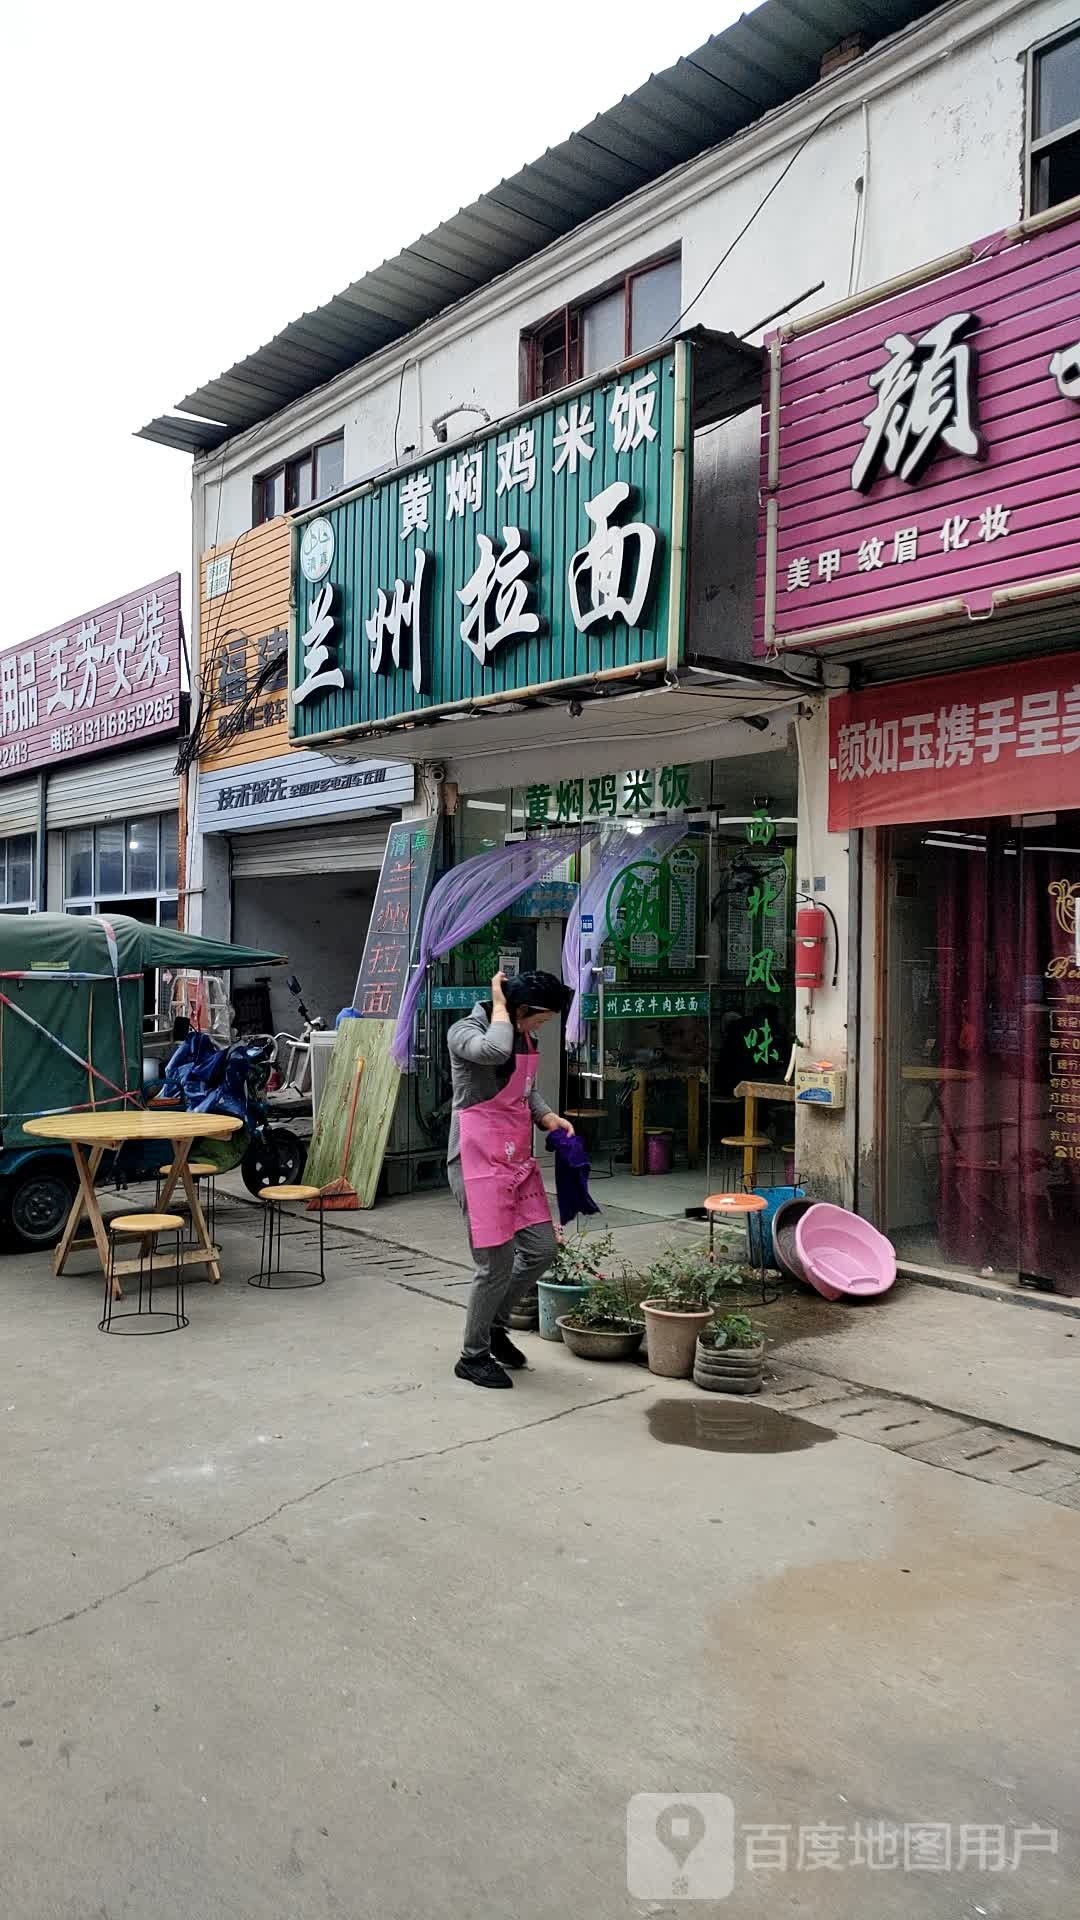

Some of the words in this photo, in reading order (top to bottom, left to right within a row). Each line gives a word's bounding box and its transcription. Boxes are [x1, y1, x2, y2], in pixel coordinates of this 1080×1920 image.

[400, 371, 658, 540] 黄焖鸡米饭
[292, 482, 657, 705] 兰州拉面
[217, 777, 288, 811] 技术领先
[390, 828, 431, 858] 清真
[525, 763, 692, 824] 黄焖鸡米饭
[361, 857, 418, 1026] 兰州拉面
[744, 808, 781, 1064] 西北风味
